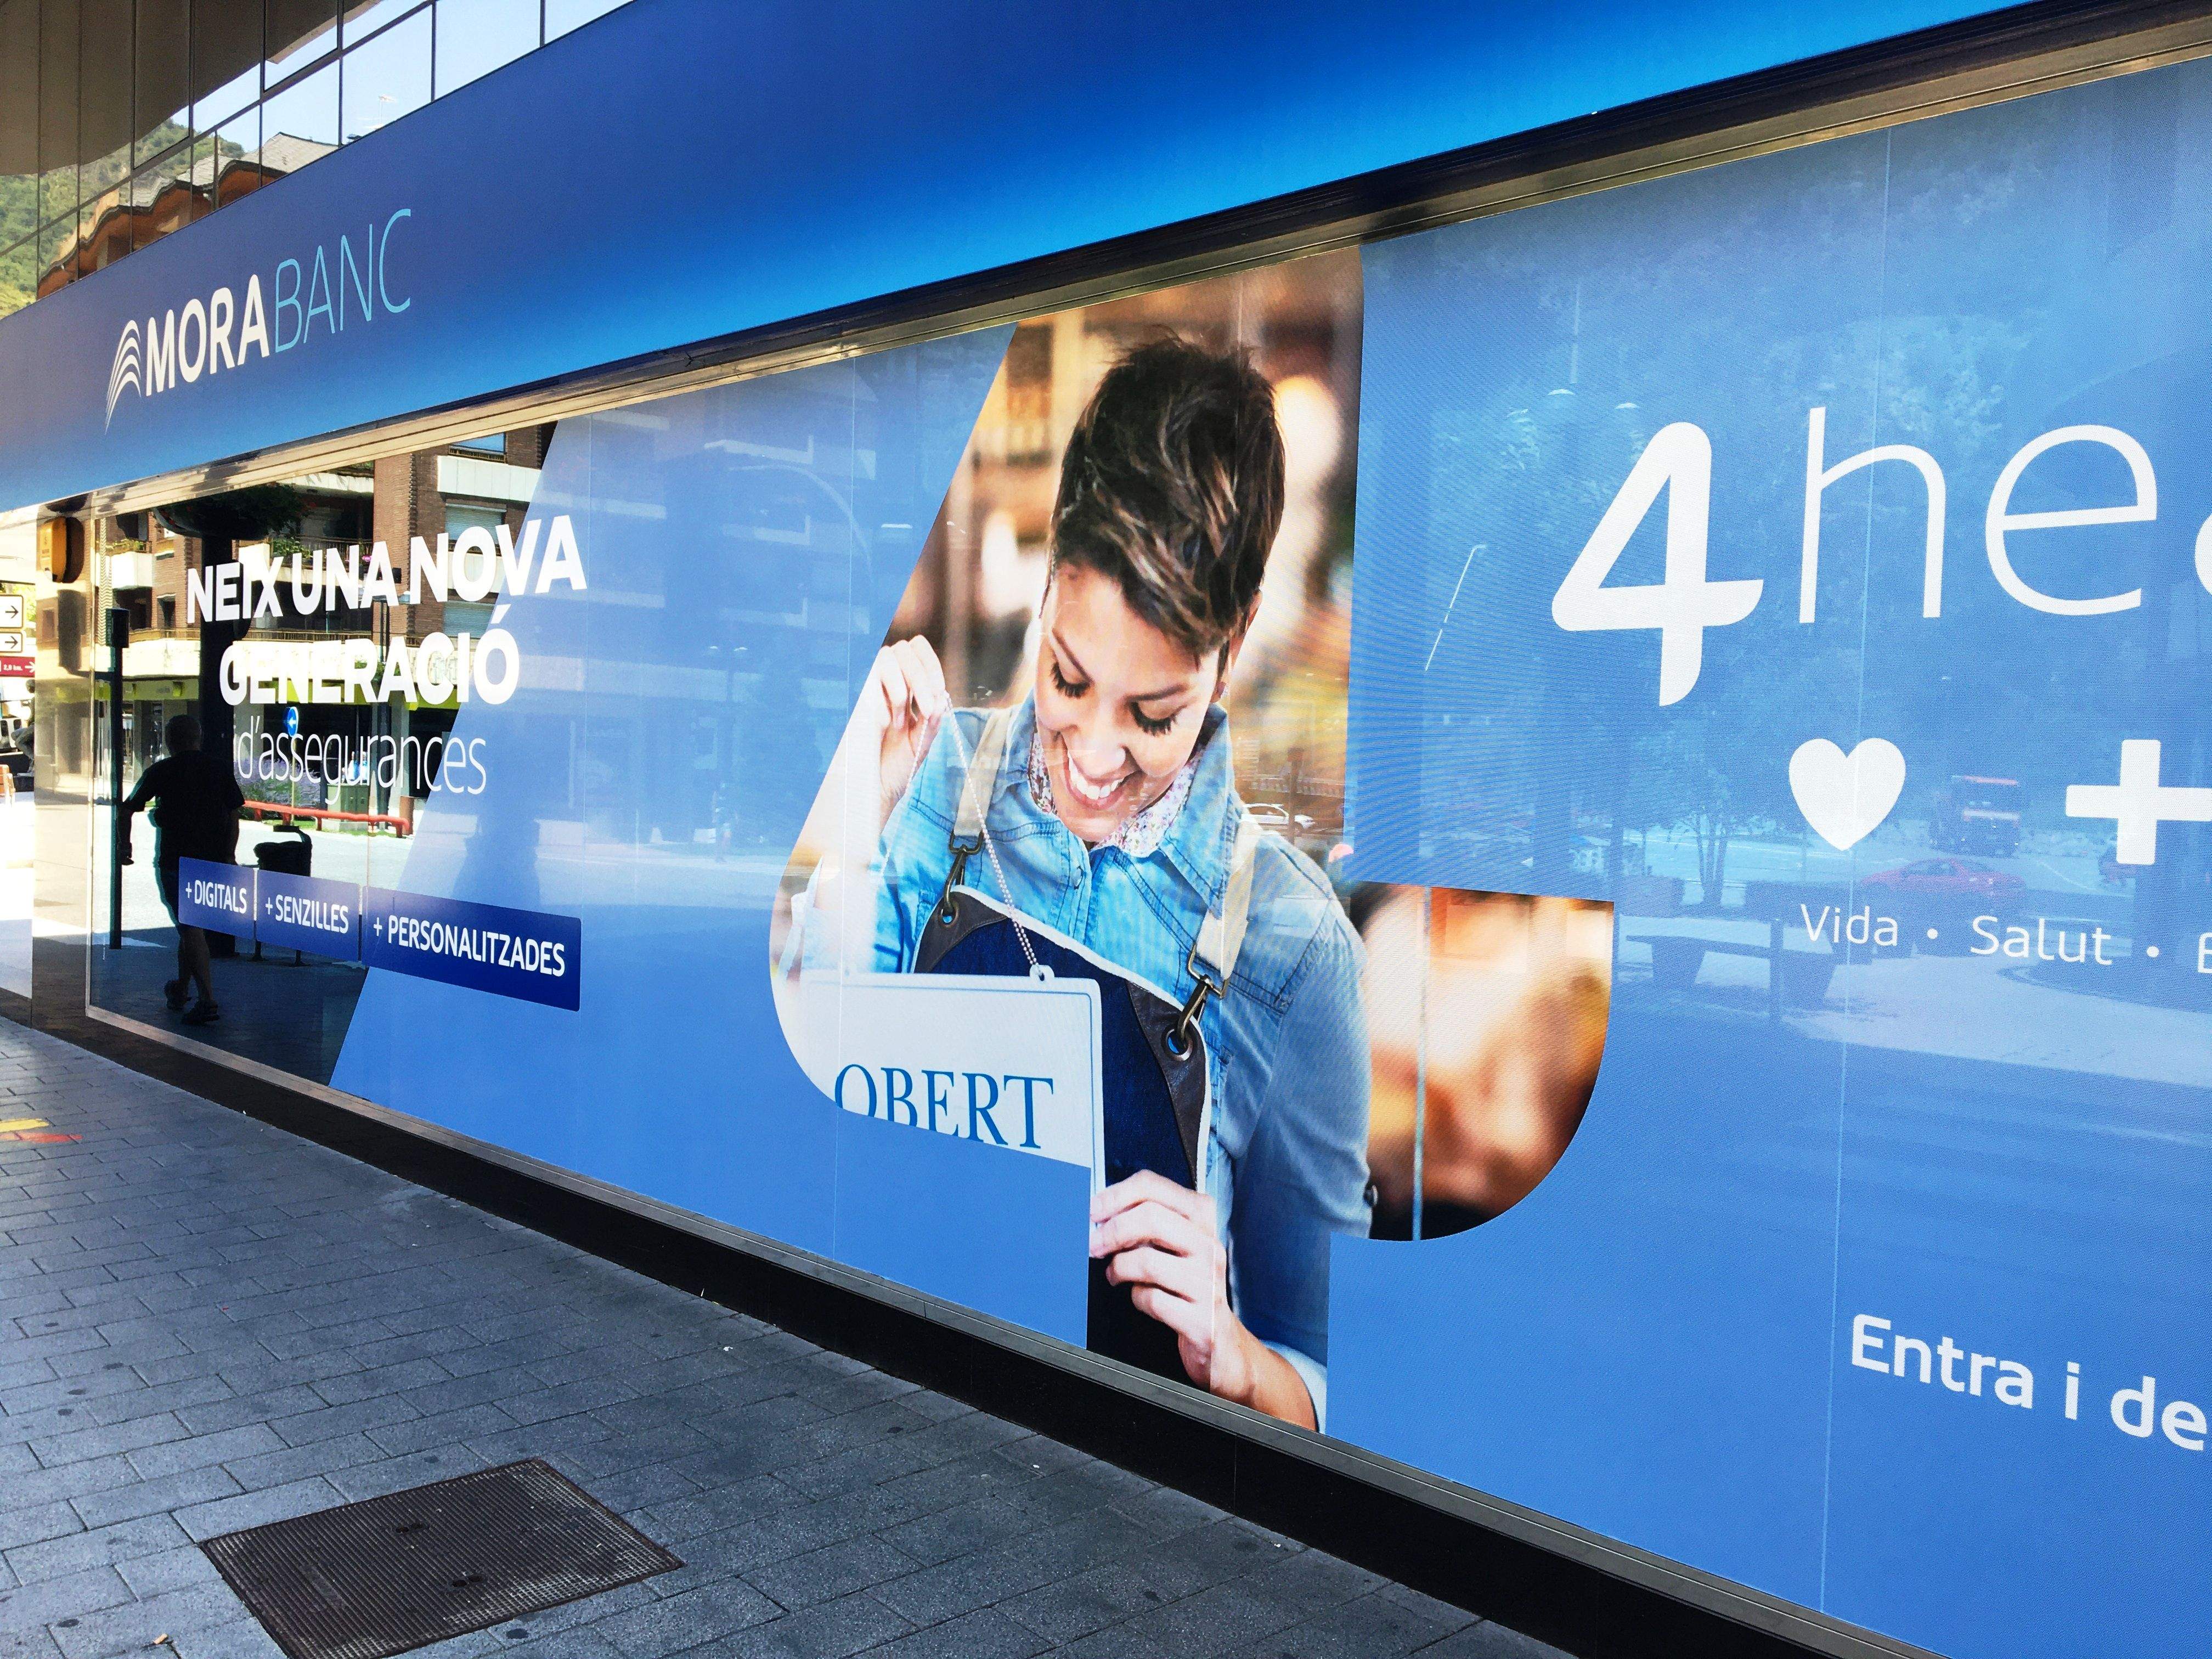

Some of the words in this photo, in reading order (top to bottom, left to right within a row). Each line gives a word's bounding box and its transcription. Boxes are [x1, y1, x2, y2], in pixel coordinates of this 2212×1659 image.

[187, 554, 283, 624] NEIX
[290, 541, 399, 615] UNA
[410, 515, 587, 605] NOVA
[219, 604, 520, 705] GENERACIÓ
[238, 715, 487, 805] d'assegurances
[388, 915, 566, 977] PERSONALITZADES
[1801, 904, 1898, 947] Vida
[1971, 915, 2113, 966] Salut
[834, 1064, 1054, 1149] OBERT
[1852, 1313, 2034, 1409] Entra
[2064, 1361, 2080, 1420] i
[2110, 1375, 2208, 1451] de
